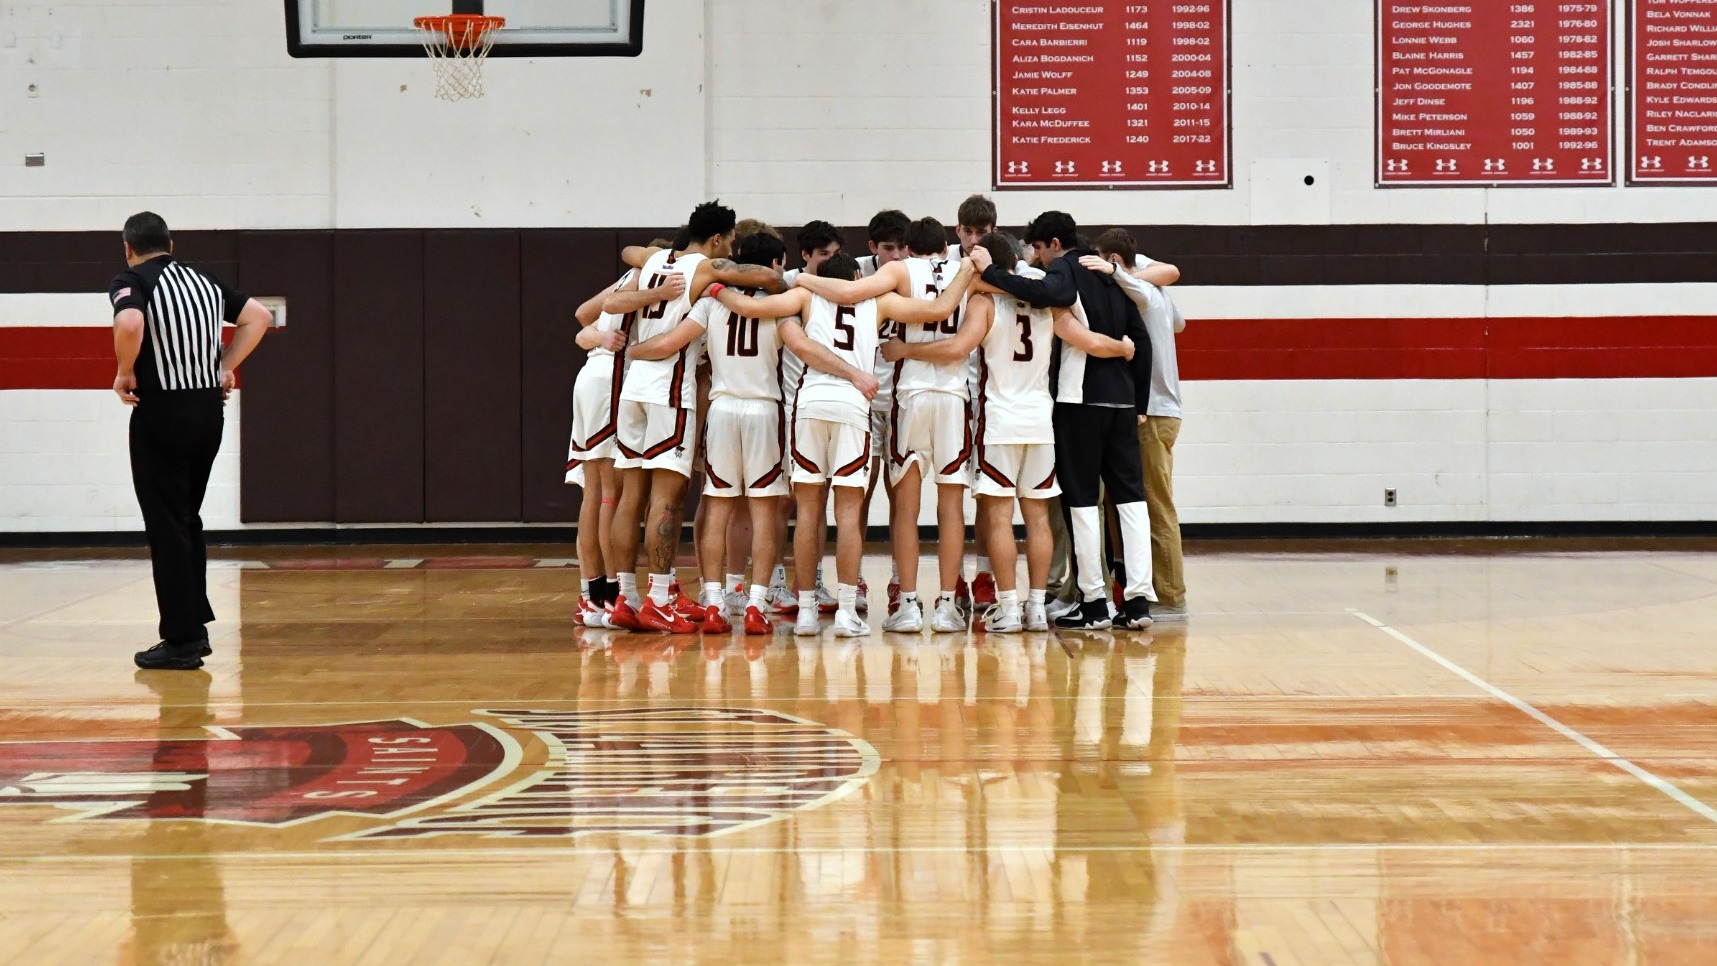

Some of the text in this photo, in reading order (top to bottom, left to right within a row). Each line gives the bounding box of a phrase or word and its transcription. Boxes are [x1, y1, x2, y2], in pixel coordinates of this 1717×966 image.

[1011, 4, 1210, 14] CRISTIN LADOUCEUR 1173 1992-96
[1391, 4, 1598, 14] DREW SKONBERG 1386 1975-79
[1646, 10, 1671, 19] BELA
[1011, 21, 1211, 31] MEREDITH EISENHUT 1464 1998-02
[1391, 19, 1598, 29] GEORGE HUGHES 2321 1976-80
[1646, 24, 1688, 33] RICHARD
[1011, 37, 1211, 47] CARA BARBIERRI 1119 1998-02
[1392, 34, 1598, 45] LONNIE WEBB 1060 1978-82
[1646, 38, 1671, 47] JOSH
[1012, 53, 1212, 63] ALIZA BOGDANICH 1152 2000-04
[1392, 50, 1599, 60] BLAINE HARRIS 1457 1982-85
[1646, 52, 1689, 61] GARRETT
[1012, 69, 1212, 79] JAMIE WOLFF 1249 2004-08
[1392, 66, 1411, 75] PAT
[1510, 66, 1535, 75] 1194
[1558, 65, 1598, 74] 1984-88
[1646, 67, 1678, 76] RALPH
[1011, 86, 1212, 95] KATIE PALMER 1353 2005-09
[1392, 81, 1598, 91] JON GOODEMOTE 1407 1985-88
[1646, 81, 1678, 90] BRADY
[1392, 96, 1598, 106] JEFF DINSE 1196 1988-92
[1646, 95, 1670, 104] KYLE
[1012, 102, 1211, 115] KELLY LEGG 1401 2010-14
[1646, 109, 1673, 118] RILEY
[1392, 111, 1598, 121] MIKE PETERSON 1059 1988-92
[1012, 119, 1039, 128] KARA
[1126, 118, 1148, 127] 1321
[1173, 118, 1211, 127] 2011-15
[1391, 127, 1598, 137] BRETT MIRLIANI 1050 1989-93
[1646, 124, 1667, 133] BEN
[1012, 134, 1212, 144] KATIE FREDERICK 1240 2017-22
[1645, 138, 1677, 147] TRENT
[1392, 141, 1599, 151] BRUCE KINGSLEY 1001 1992-96
[833, 306, 856, 351] 5
[726, 311, 760, 357] 10
[1013, 314, 1034, 362] 3
[303, 737, 439, 799] SAINTS
